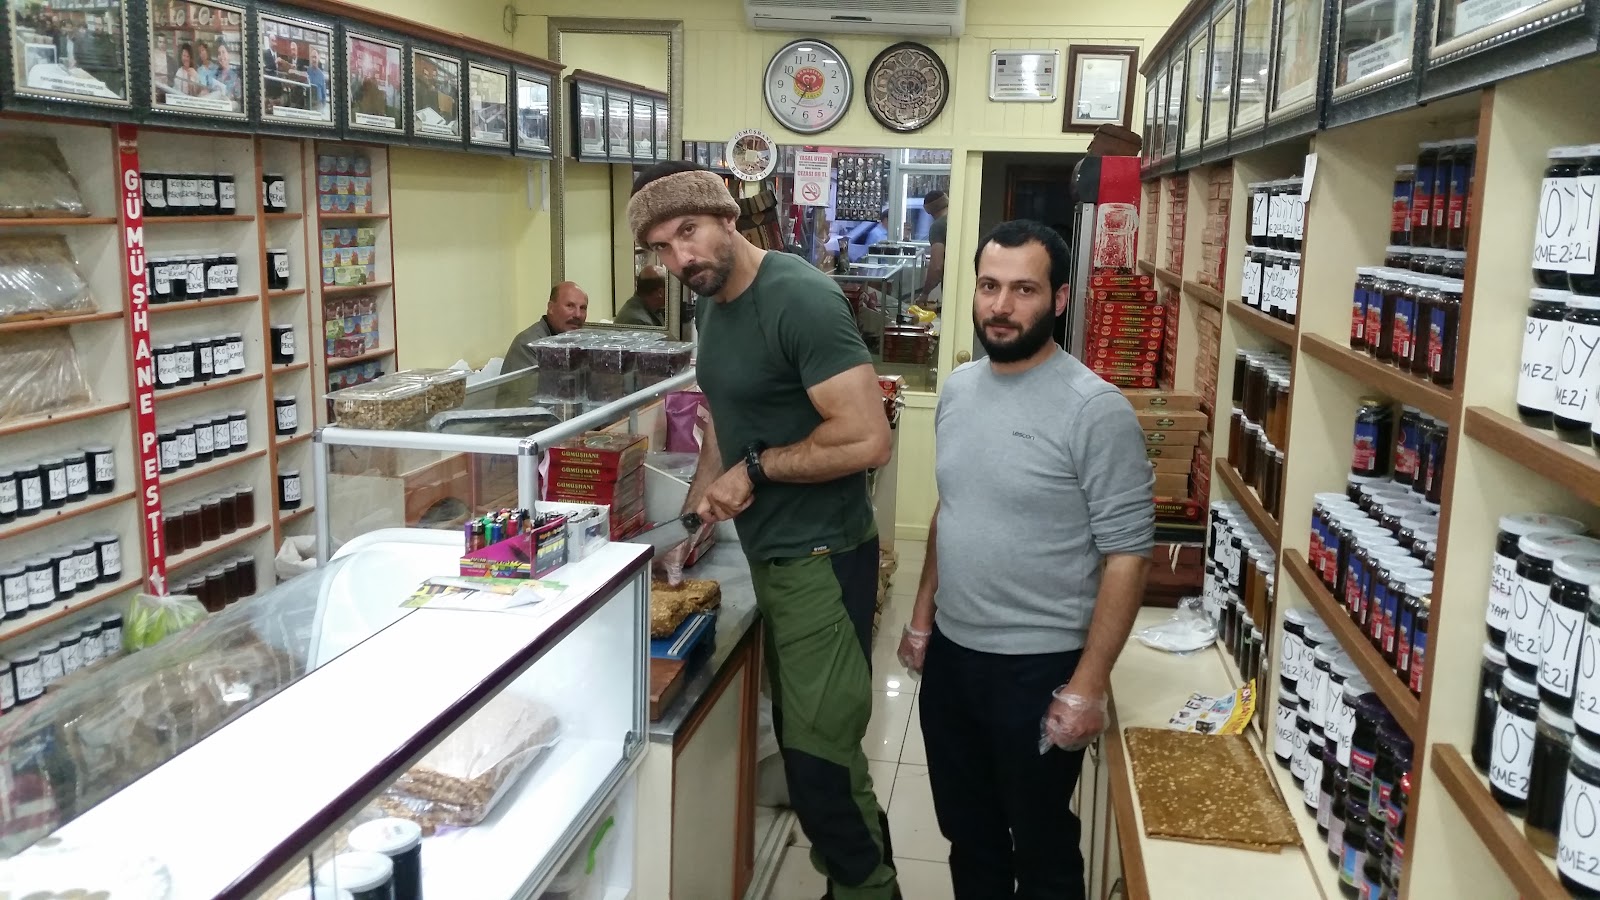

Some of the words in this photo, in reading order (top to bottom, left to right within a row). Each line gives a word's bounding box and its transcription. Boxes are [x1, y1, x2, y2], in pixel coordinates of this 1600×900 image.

[795, 56, 802, 65] 11
[807, 53, 816, 63] 12
[784, 65, 793, 74] 10
[831, 70, 837, 79] 2
[777, 80, 784, 89] 9
[832, 85, 840, 94] 3
[780, 94, 787, 103] 8
[827, 100, 833, 108] 4
[790, 107, 797, 115] 7
[802, 110, 809, 119] 6
[816, 109, 823, 118] 5
[123, 168, 156, 416] GÜMÜŞHANE
[141, 431, 166, 594] PESTİ
[561, 450, 600, 459] GÜMÜŞHANE
[561, 466, 601, 475] GÜMÜŞHANE
[556, 482, 594, 490] GÜMÜŞHANE
